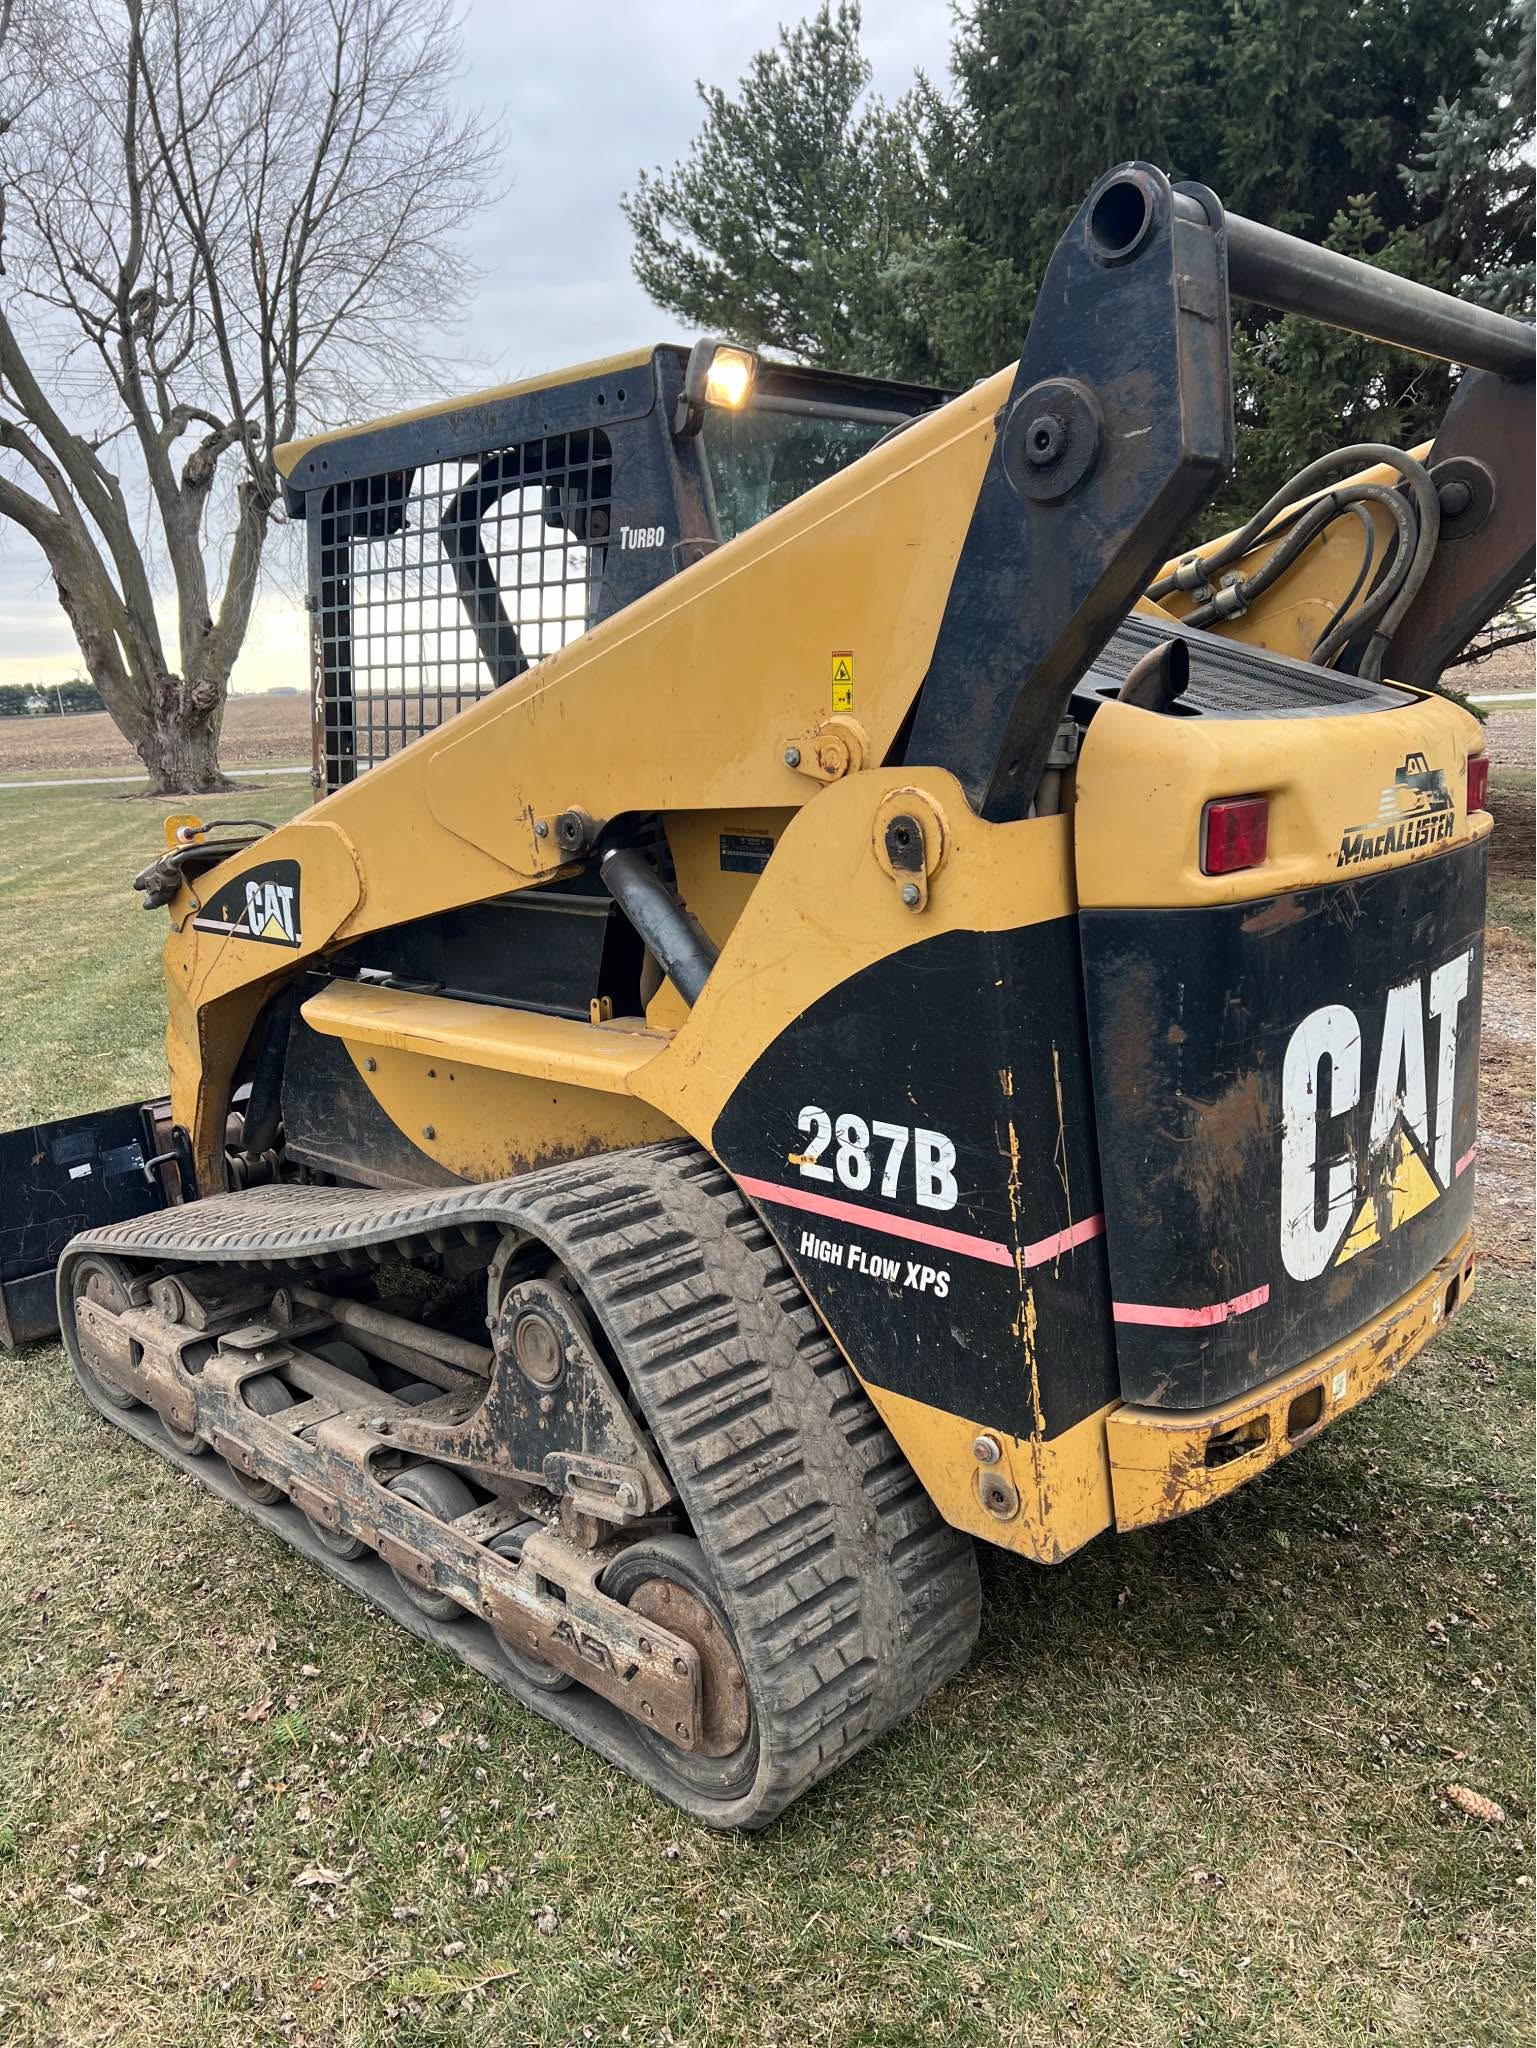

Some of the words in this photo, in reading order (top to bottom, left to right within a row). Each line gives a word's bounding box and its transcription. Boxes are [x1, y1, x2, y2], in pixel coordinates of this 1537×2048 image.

[620, 525, 665, 550] TURBO
[245, 881, 294, 942] CAT
[1280, 950, 1471, 1282] CAT
[797, 1105, 958, 1211] 287B
[800, 1231, 843, 1267] HIGH
[847, 1244, 900, 1283] FLOW
[903, 1260, 951, 1299] XPS
